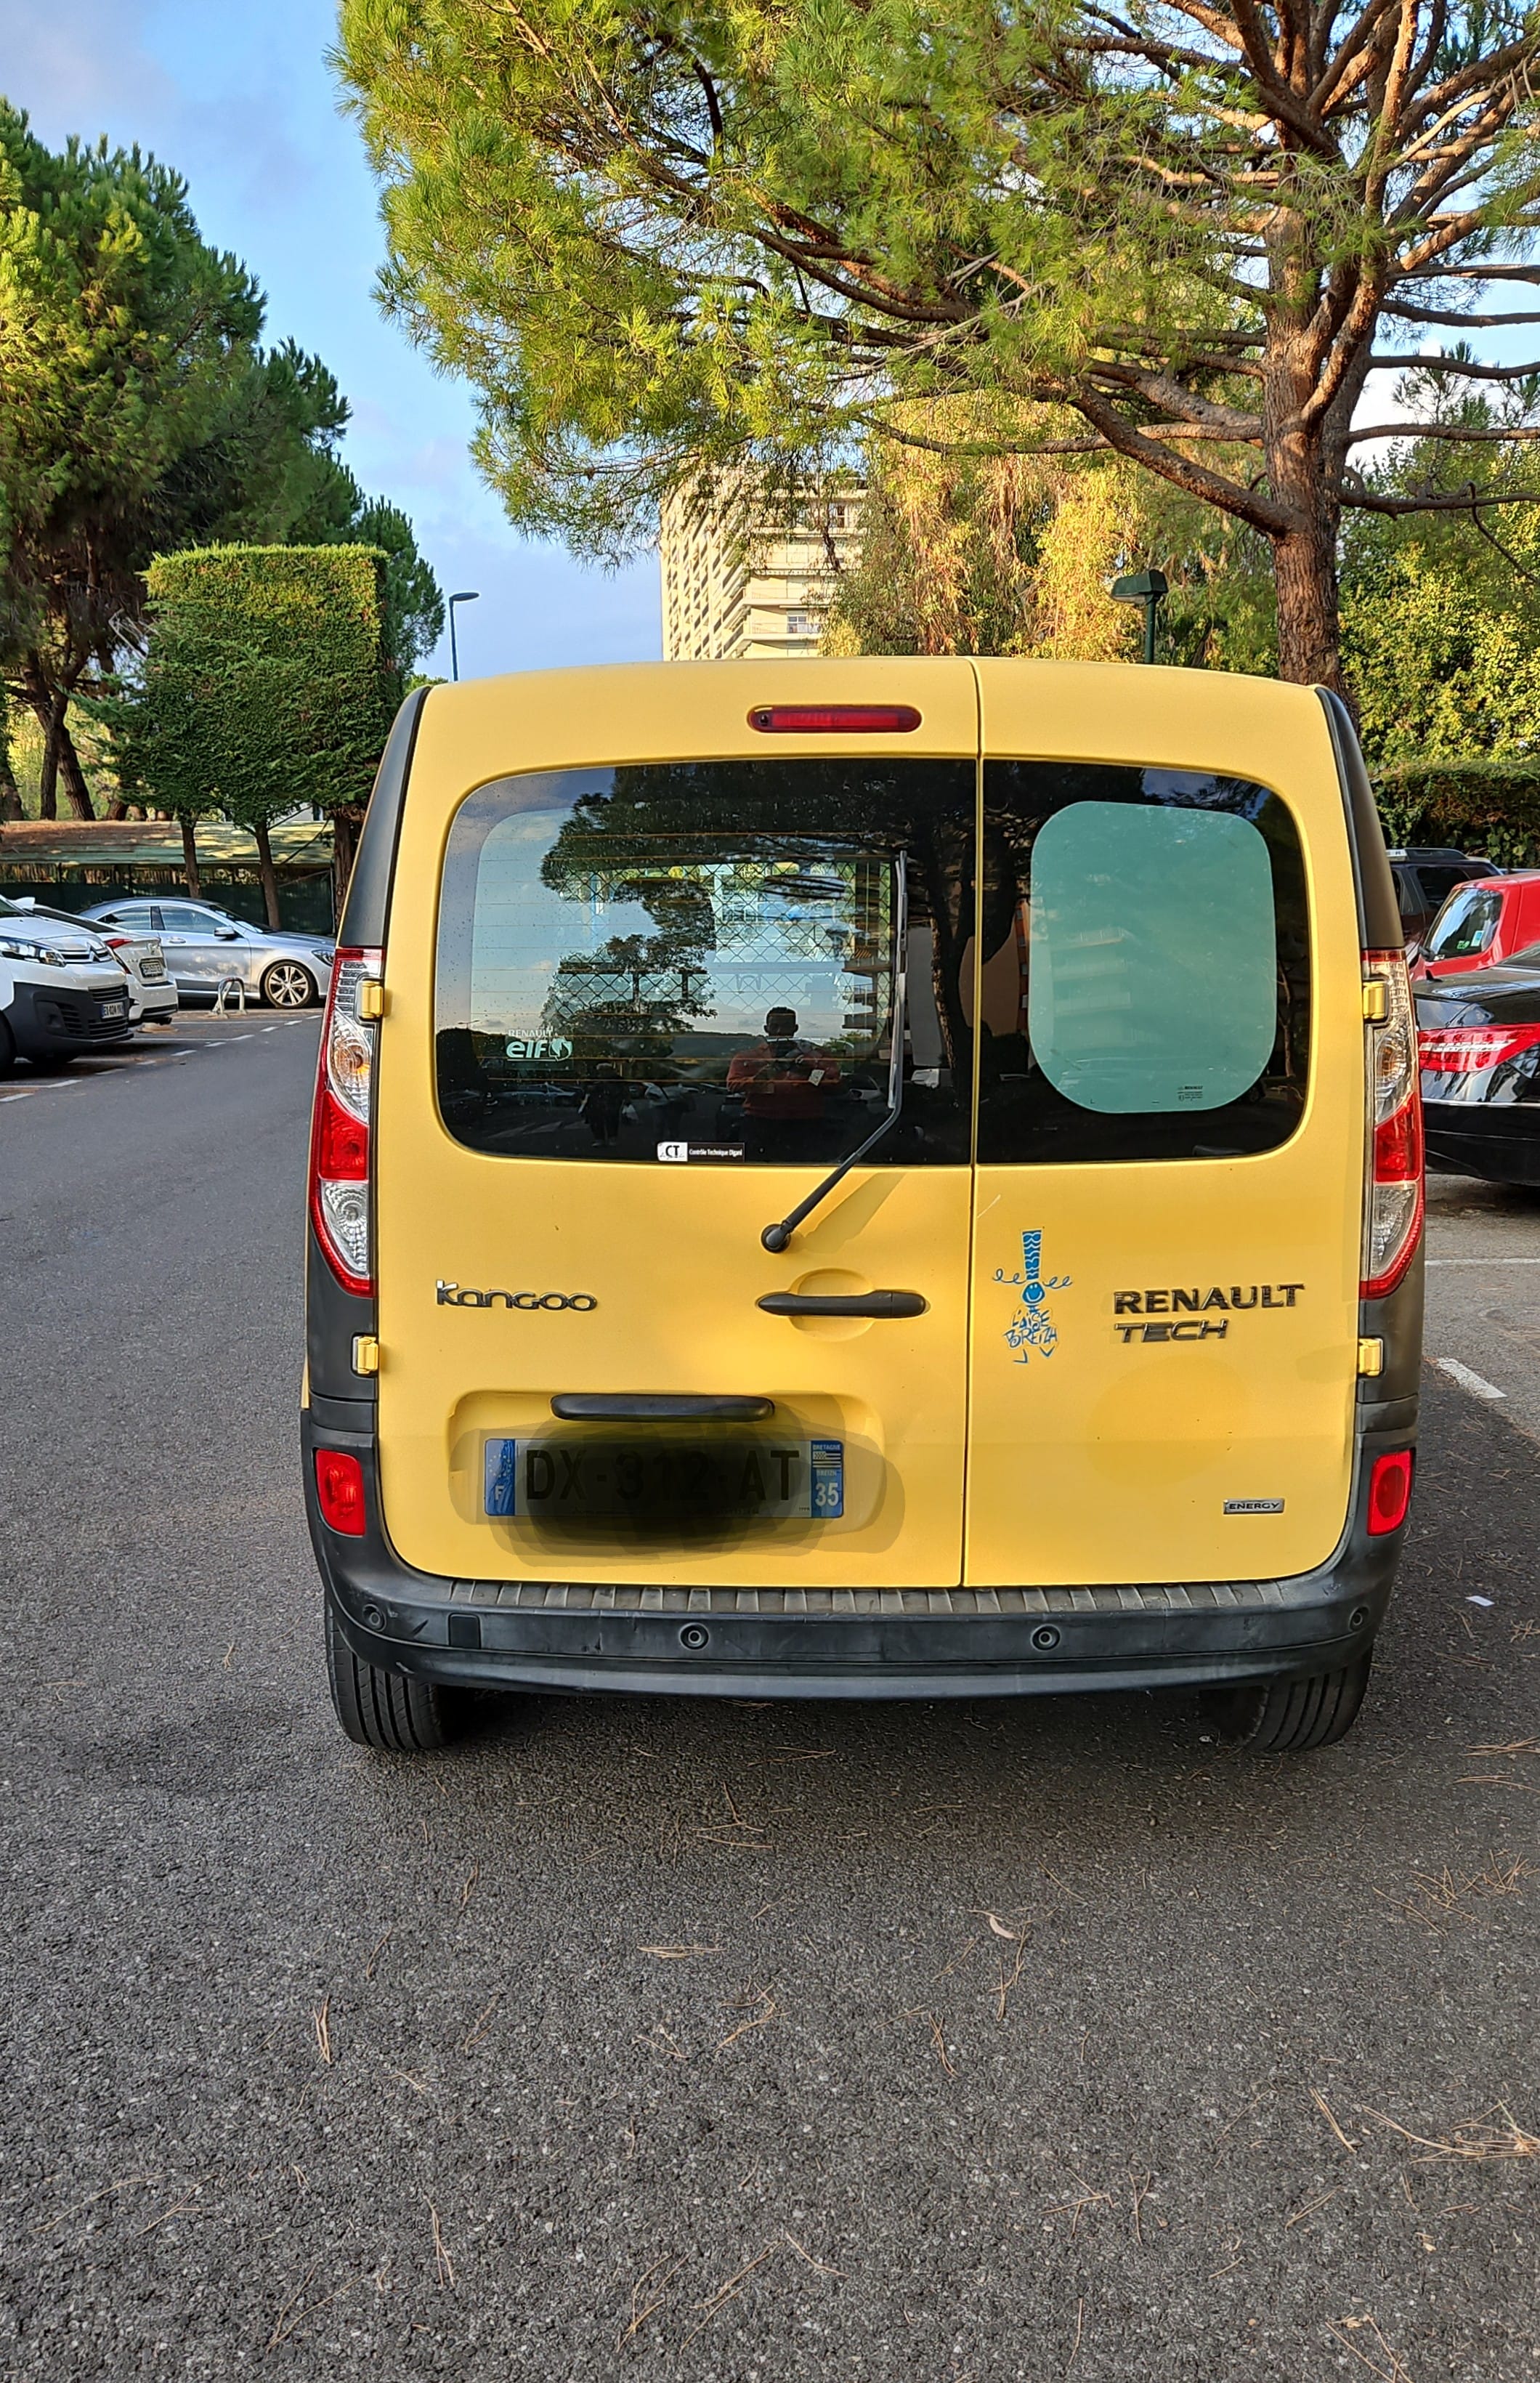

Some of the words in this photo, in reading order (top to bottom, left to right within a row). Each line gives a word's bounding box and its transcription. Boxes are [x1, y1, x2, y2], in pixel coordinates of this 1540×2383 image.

[506, 1039, 548, 1059] elf
[665, 1145, 680, 1158] CT
[1114, 1284, 1305, 1314] RENAULT
[1114, 1319, 1229, 1343] TECH
[495, 1485, 504, 1500] F
[815, 1482, 839, 1506] 35
